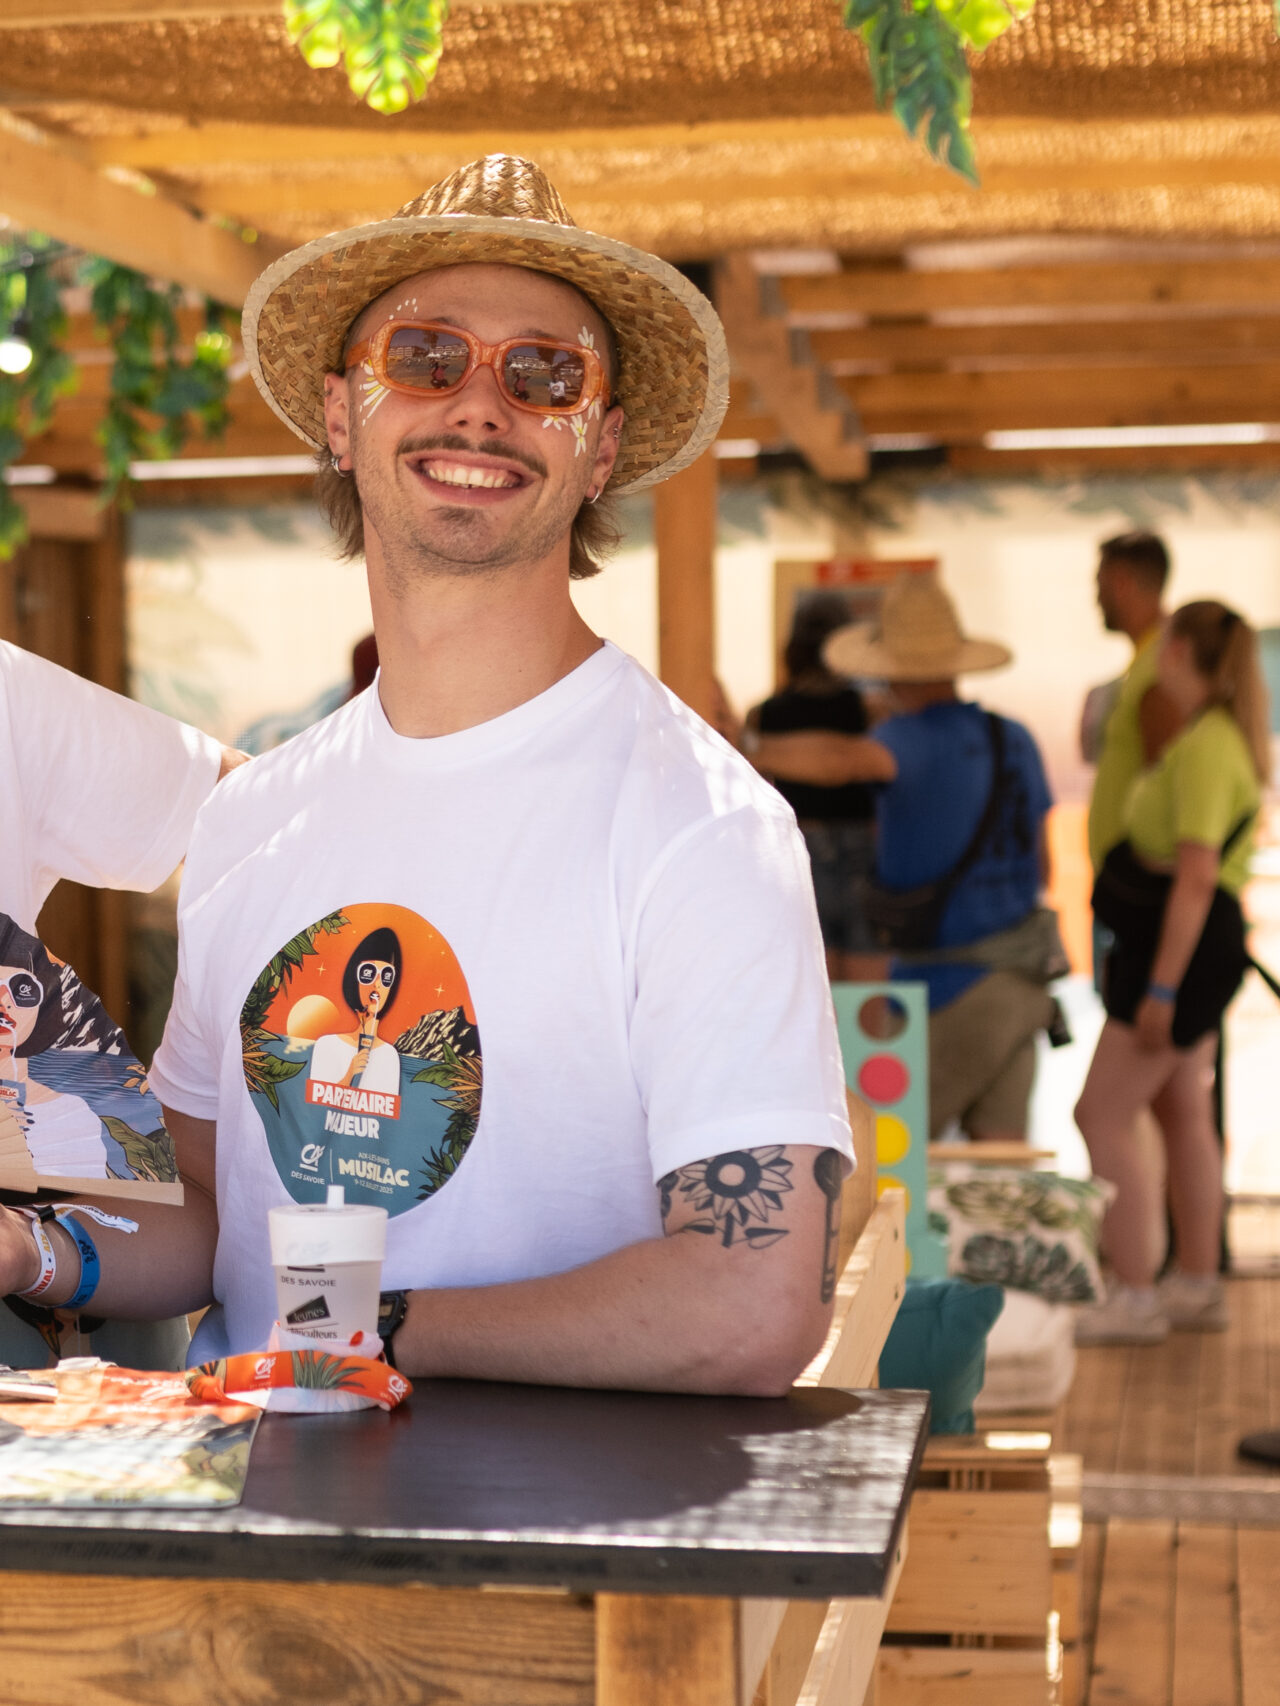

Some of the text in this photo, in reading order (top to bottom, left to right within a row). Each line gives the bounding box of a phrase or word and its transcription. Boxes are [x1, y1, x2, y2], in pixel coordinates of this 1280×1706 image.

[312, 1082, 395, 1117] PARTENAIRE
[324, 1110, 380, 1139] MAJEUR
[291, 1171, 325, 1185] DES SAVOIE
[338, 1158, 410, 1187] MUSILAC
[281, 1276, 337, 1287] DES SAVOIE
